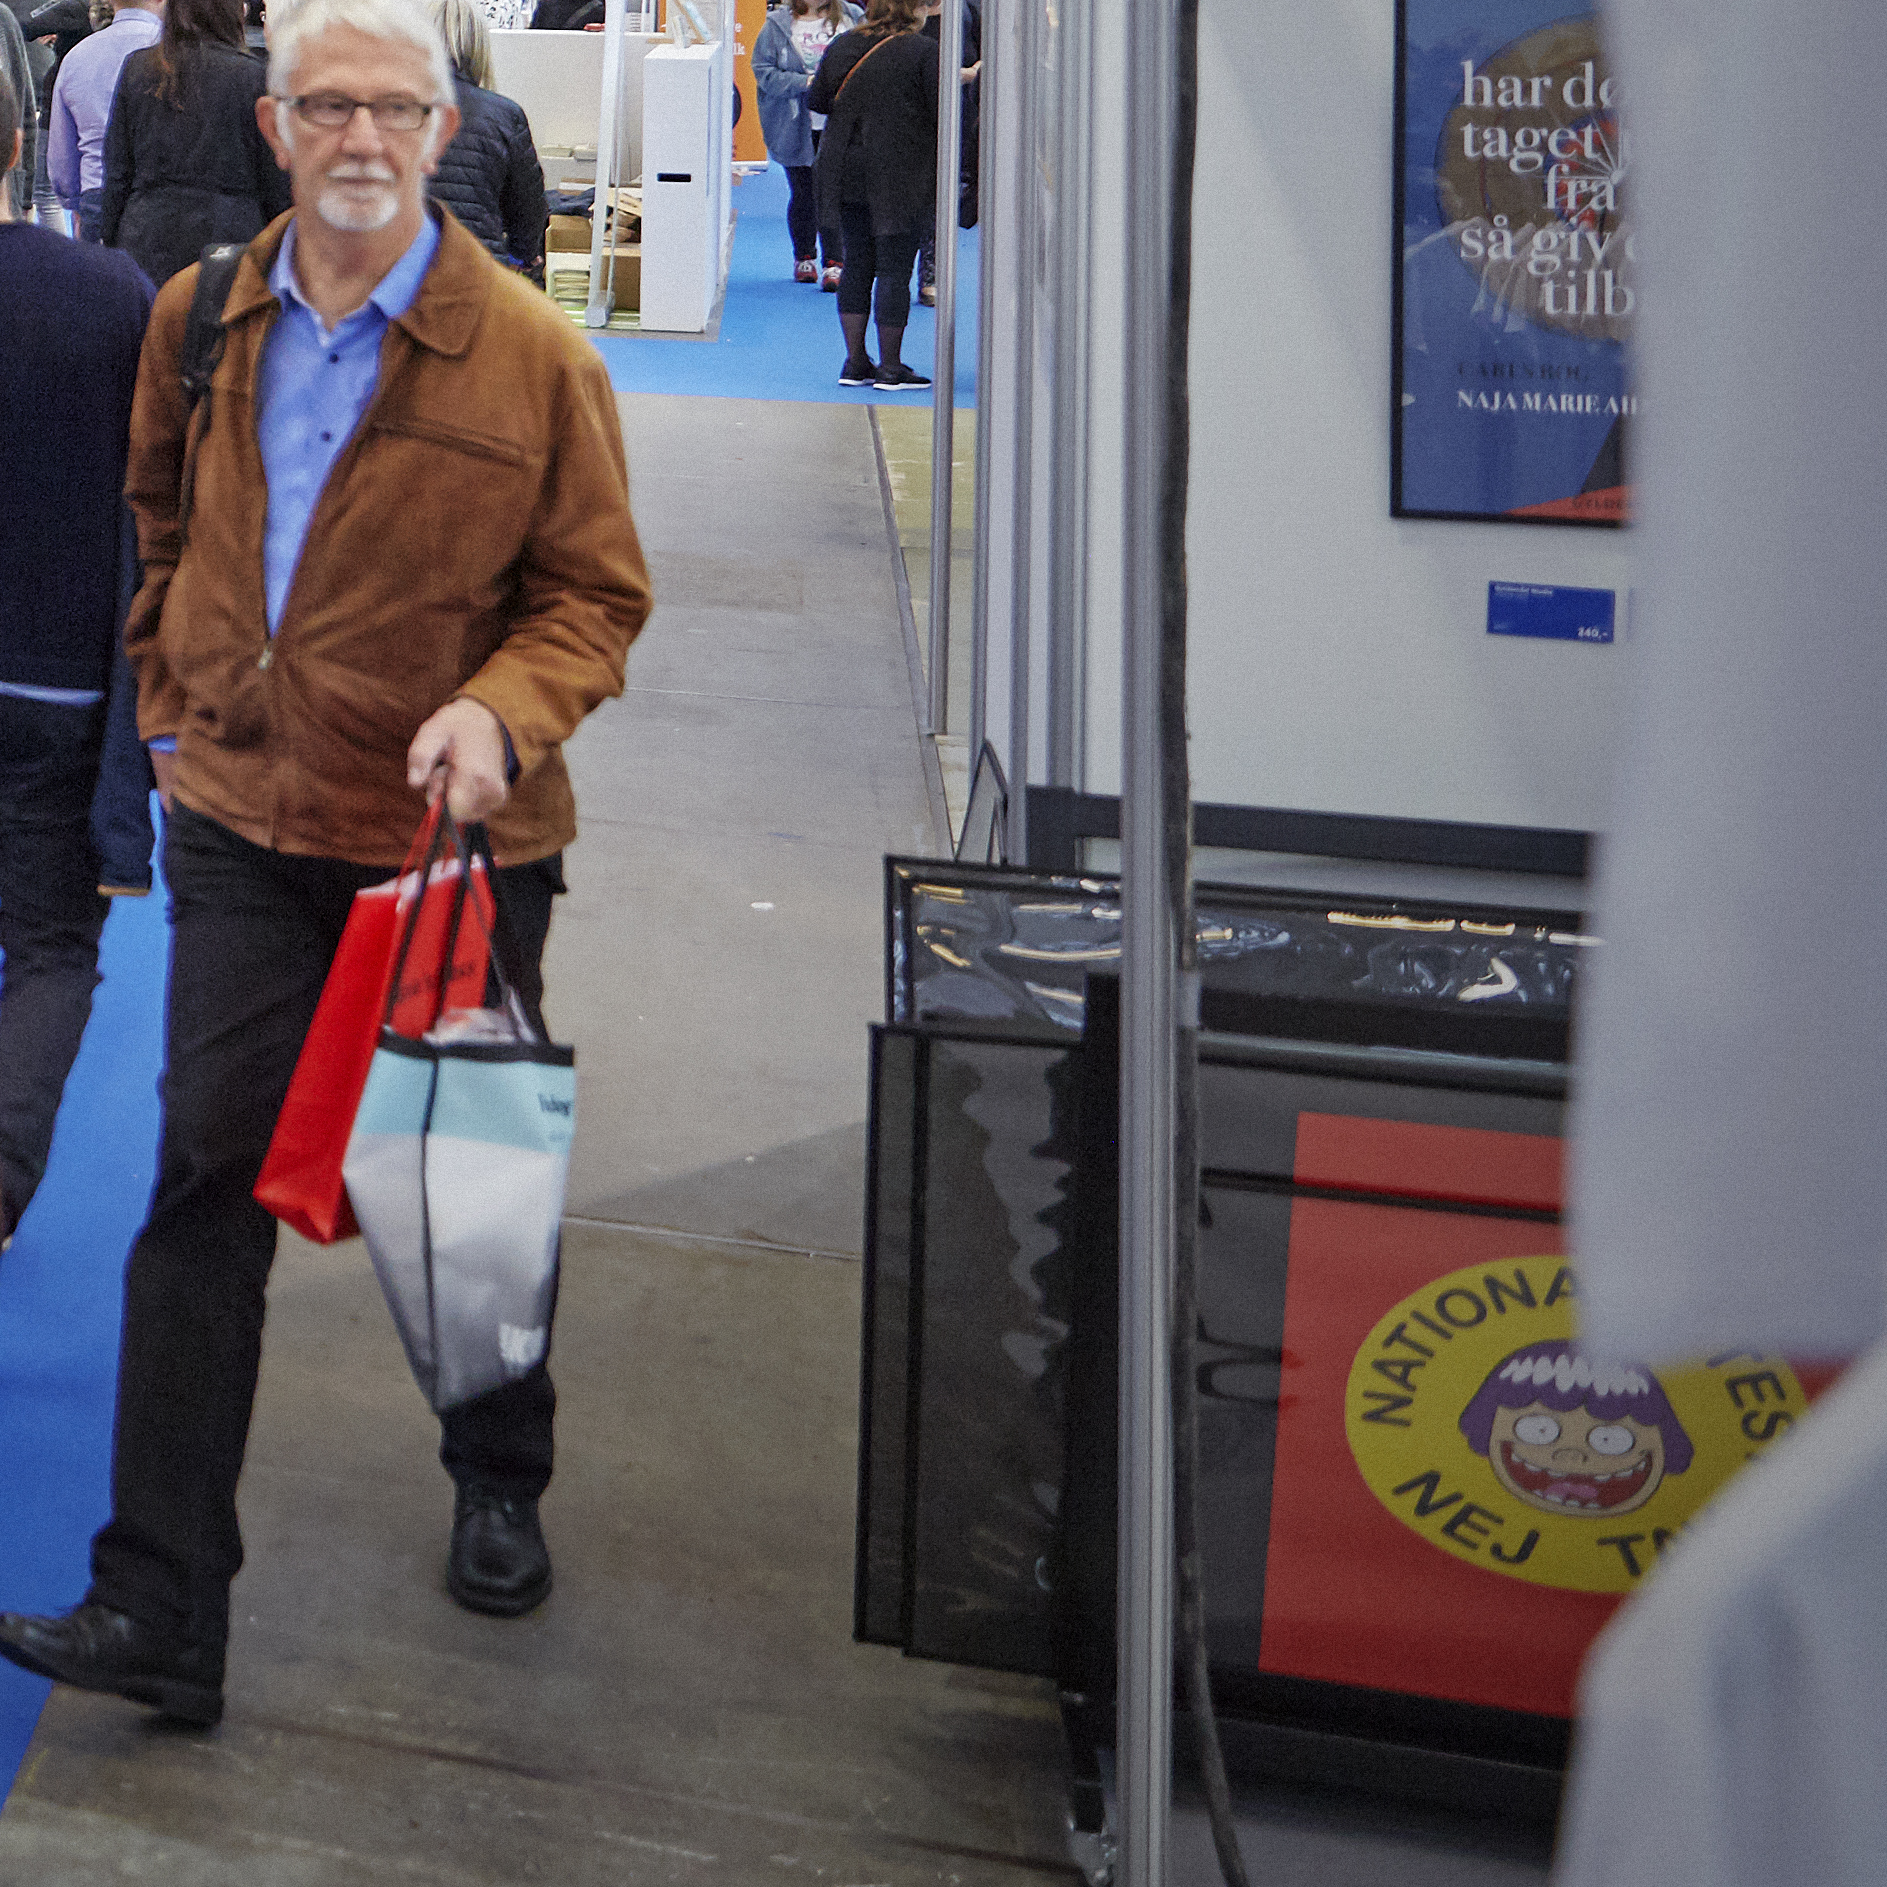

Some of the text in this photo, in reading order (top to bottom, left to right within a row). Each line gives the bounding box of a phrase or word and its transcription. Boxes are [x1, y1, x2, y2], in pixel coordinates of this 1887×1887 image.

[1460, 60, 1553, 108] har
[1460, 122, 1604, 174] taget
[1544, 162, 1617, 212] fra
[1460, 214, 1612, 277] så giv
[1457, 389, 1518, 412] NAJA
[1522, 392, 1599, 414] MARIE
[1391, 1469, 1541, 1566] NEJ
